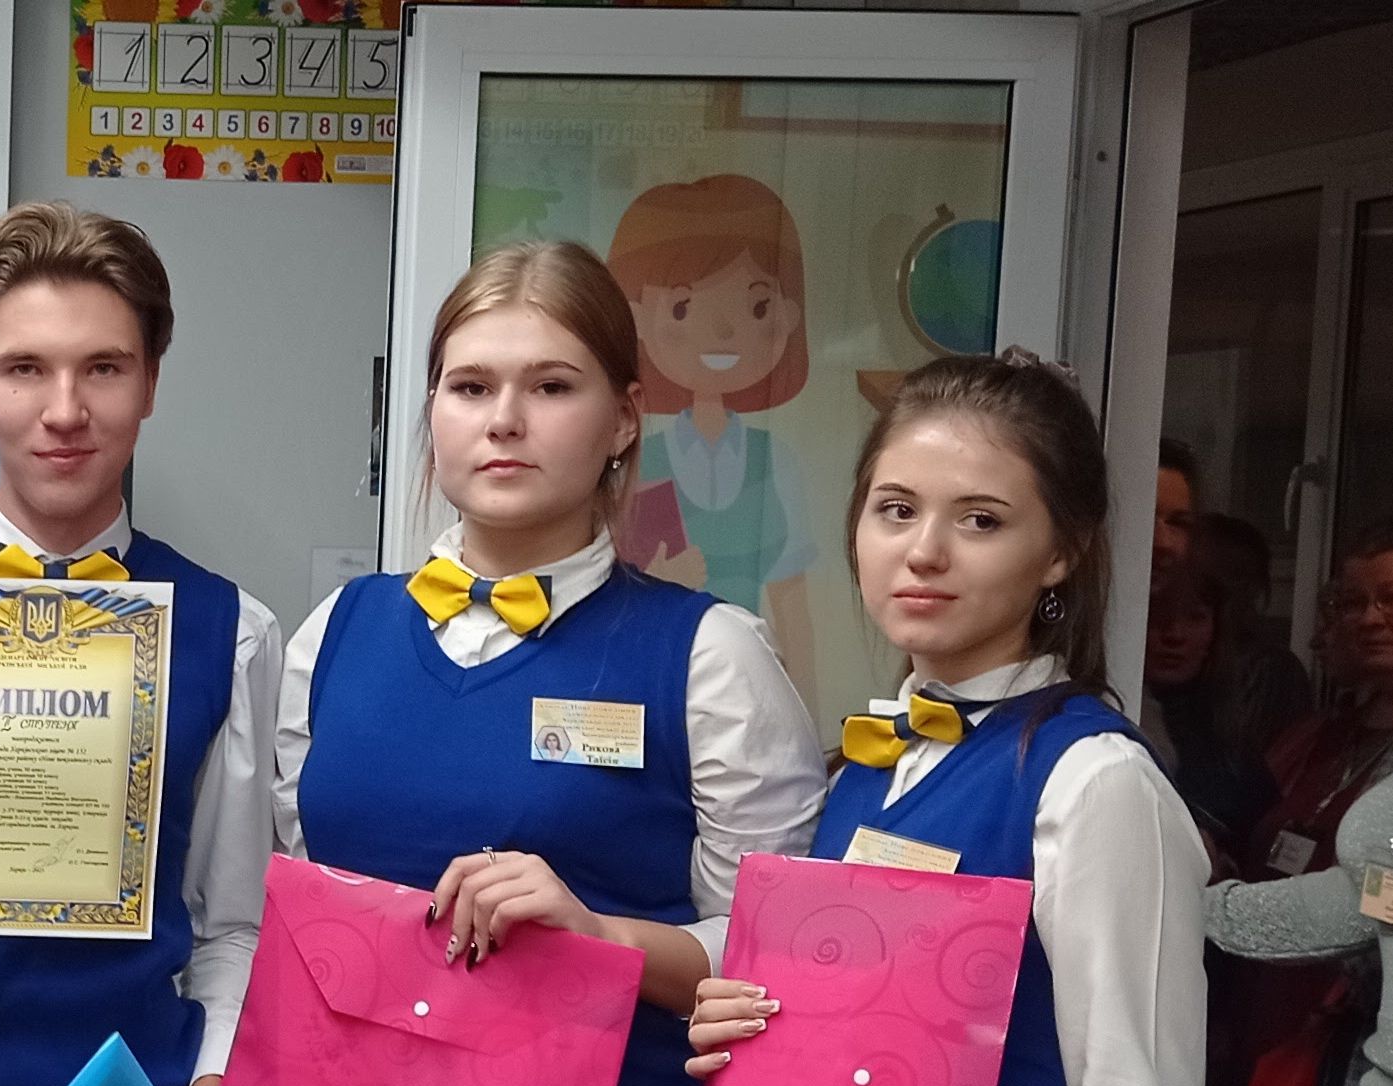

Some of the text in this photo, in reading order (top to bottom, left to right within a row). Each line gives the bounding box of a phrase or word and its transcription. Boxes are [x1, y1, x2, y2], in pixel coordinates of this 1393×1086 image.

[124, 30, 398, 89] 1 2 3 4 5
[99, 112, 109, 130] 1
[131, 112, 143, 130] 2
[162, 113, 174, 131] 3
[192, 113, 205, 132] 4
[226, 114, 239, 132] 5
[257, 114, 270, 133] 6
[288, 115, 300, 134] 7
[319, 116, 331, 135] 8
[350, 118, 362, 136] 9
